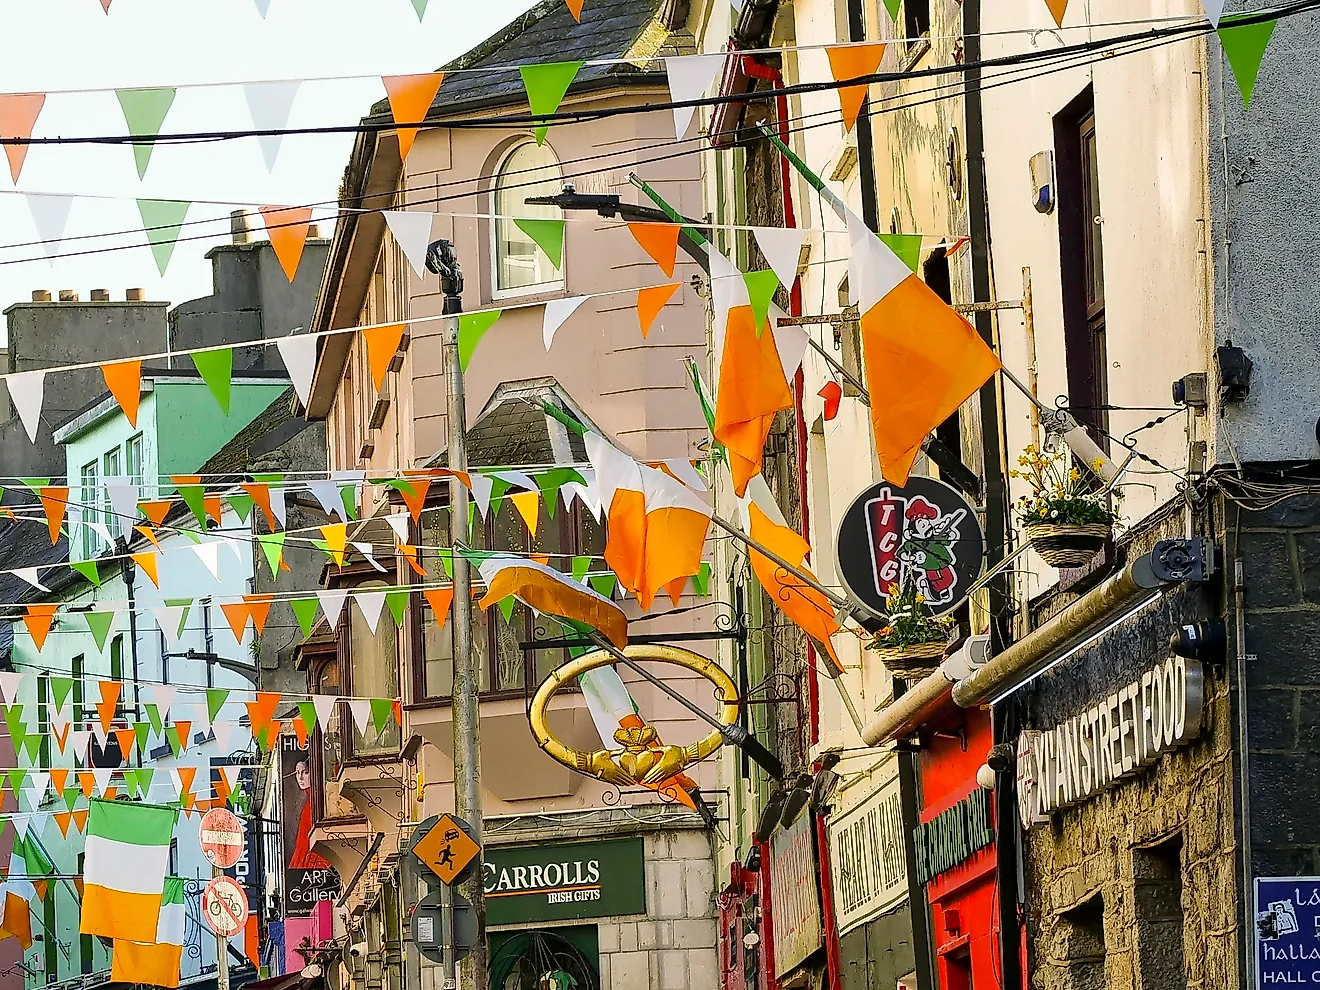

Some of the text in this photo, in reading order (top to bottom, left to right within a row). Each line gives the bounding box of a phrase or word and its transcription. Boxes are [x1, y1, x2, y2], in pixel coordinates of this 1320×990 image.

[1080, 681, 1140, 796] STREET
[1142, 655, 1186, 760] FOOD
[301, 870, 327, 885] ART
[548, 889, 601, 904] IRISH GIFTS
[1263, 971, 1307, 983] HALL
